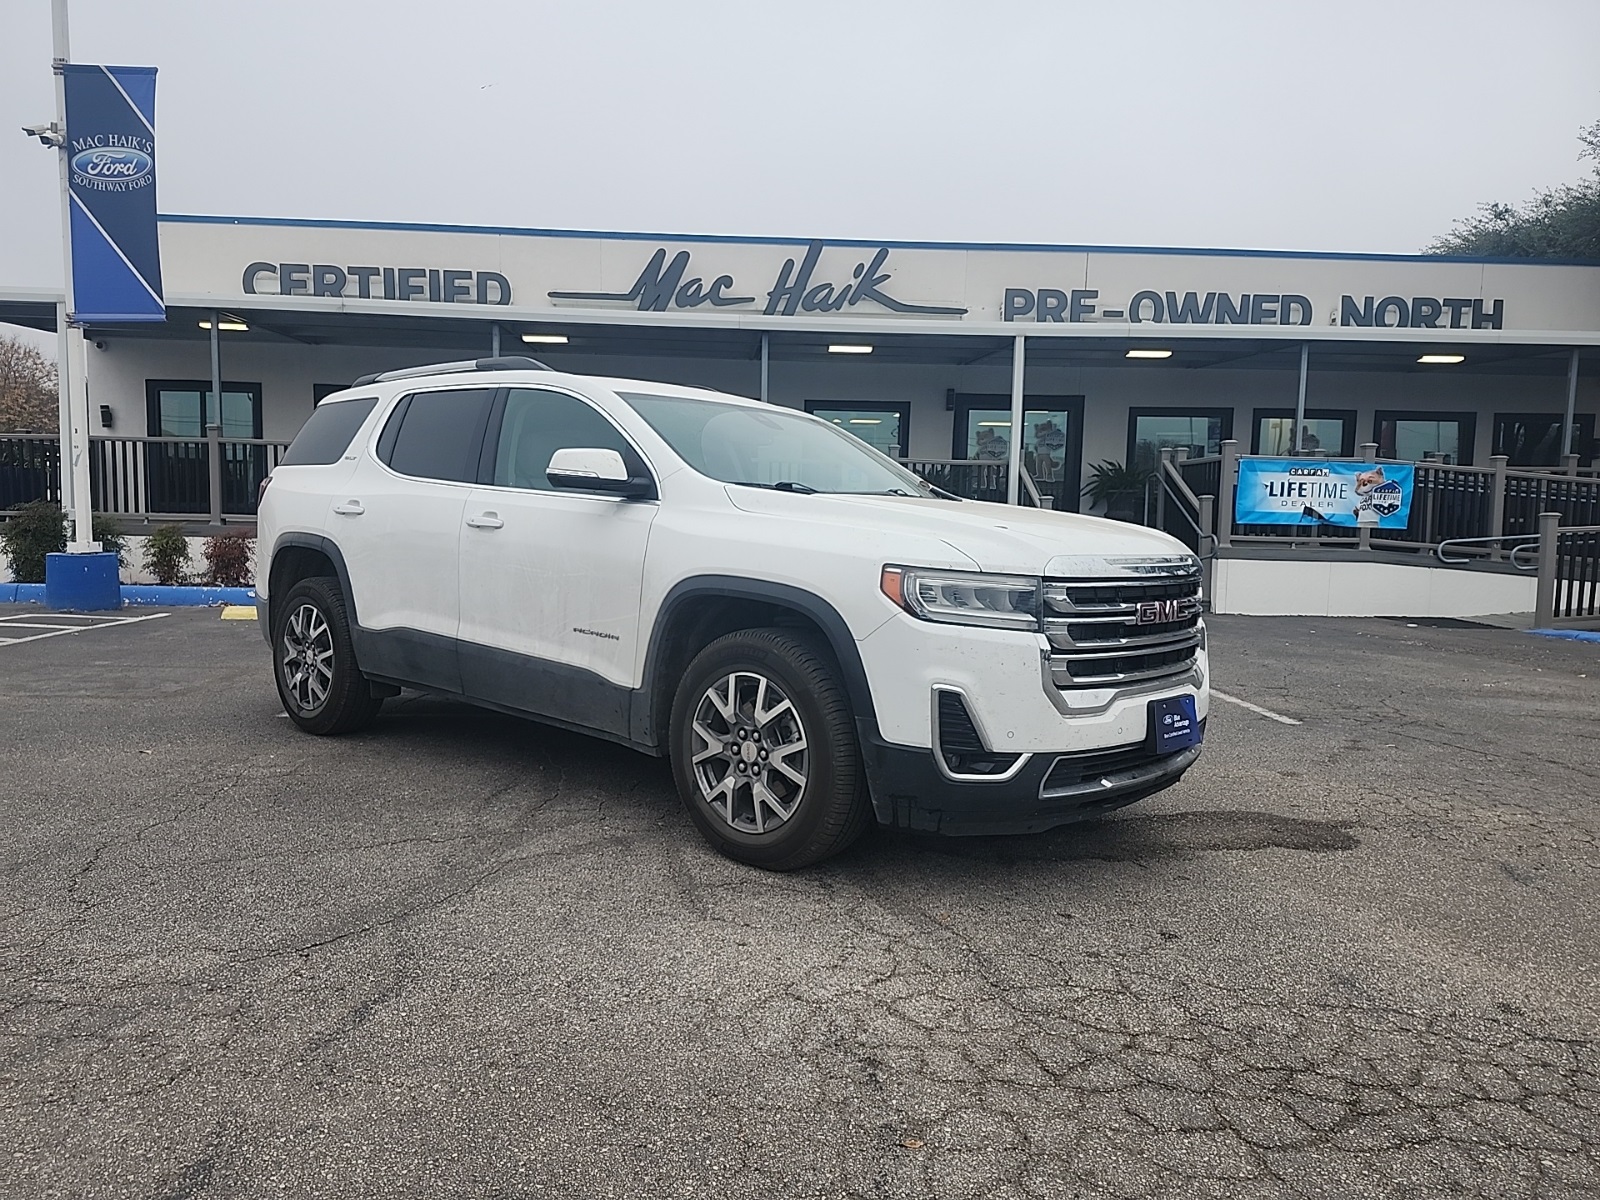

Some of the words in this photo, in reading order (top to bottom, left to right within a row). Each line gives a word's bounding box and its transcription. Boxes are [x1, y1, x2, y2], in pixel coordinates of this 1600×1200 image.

[72, 134, 104, 152] MAC
[108, 134, 154, 153] HAIK'S
[87, 152, 138, 176] Ford
[72, 173, 127, 192] SOUTHWAY
[128, 174, 153, 191] FORD
[242, 261, 513, 306] CERTIFIED
[626, 247, 756, 312] Mac
[762, 239, 910, 317] Haik
[1003, 287, 1312, 328] PRE-OWNED
[1339, 294, 1504, 331] NORTH
[1289, 468, 1330, 477] CARFAX
[1269, 480, 1348, 499] LIFETIME
[1373, 494, 1400, 502] LIFETIME
[1281, 500, 1335, 508] DEALER
[1136, 600, 1192, 626] GMC
